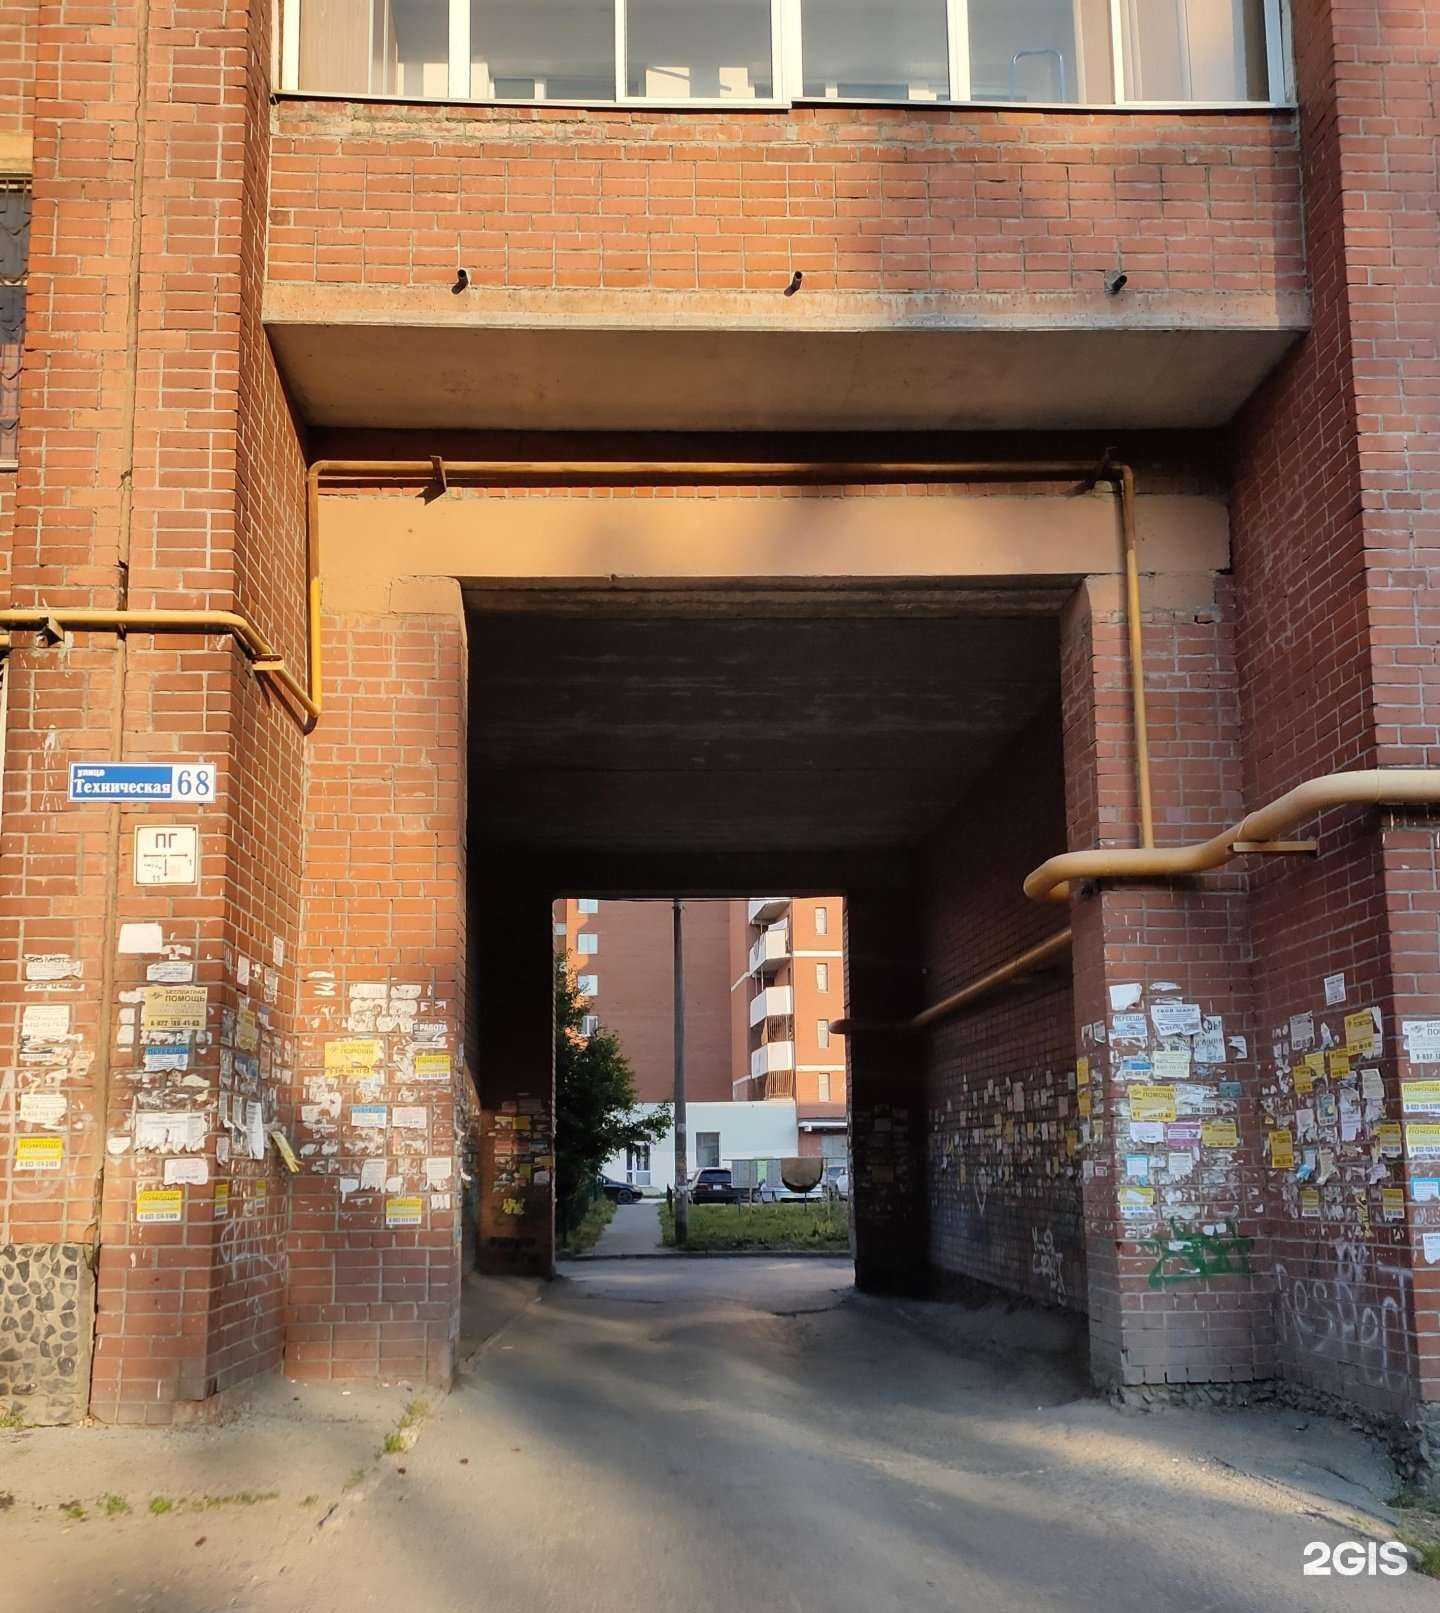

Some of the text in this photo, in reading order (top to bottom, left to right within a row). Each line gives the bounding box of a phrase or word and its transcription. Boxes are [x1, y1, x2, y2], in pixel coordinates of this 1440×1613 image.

[77, 768, 105, 777] улица
[73, 779, 171, 793] Техническая
[177, 770, 210, 795] 68
[155, 833, 178, 848] ПГ
[165, 995, 206, 1003] ПОМОЩЬ
